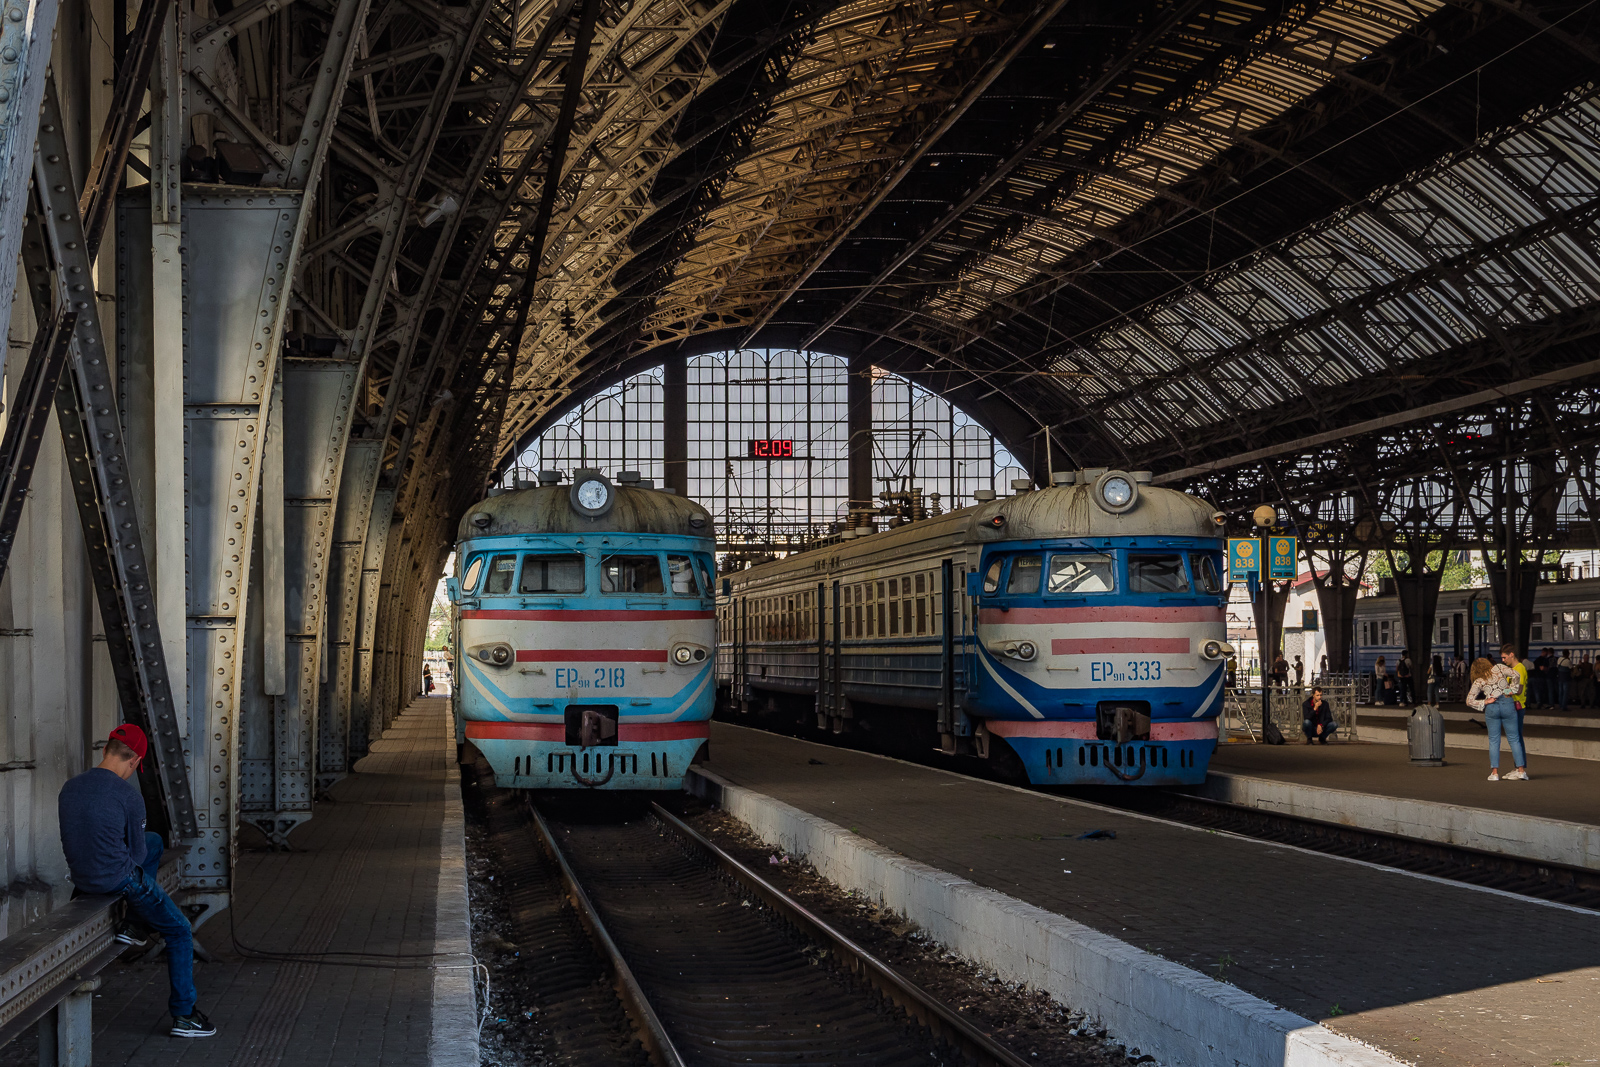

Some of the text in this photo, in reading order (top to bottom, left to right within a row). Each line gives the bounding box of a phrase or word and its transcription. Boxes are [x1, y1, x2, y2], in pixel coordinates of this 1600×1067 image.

[1235, 558, 1255, 568] 838
[1275, 556, 1291, 566] 838
[595, 667, 624, 688] 218
[1128, 660, 1161, 680] 333
